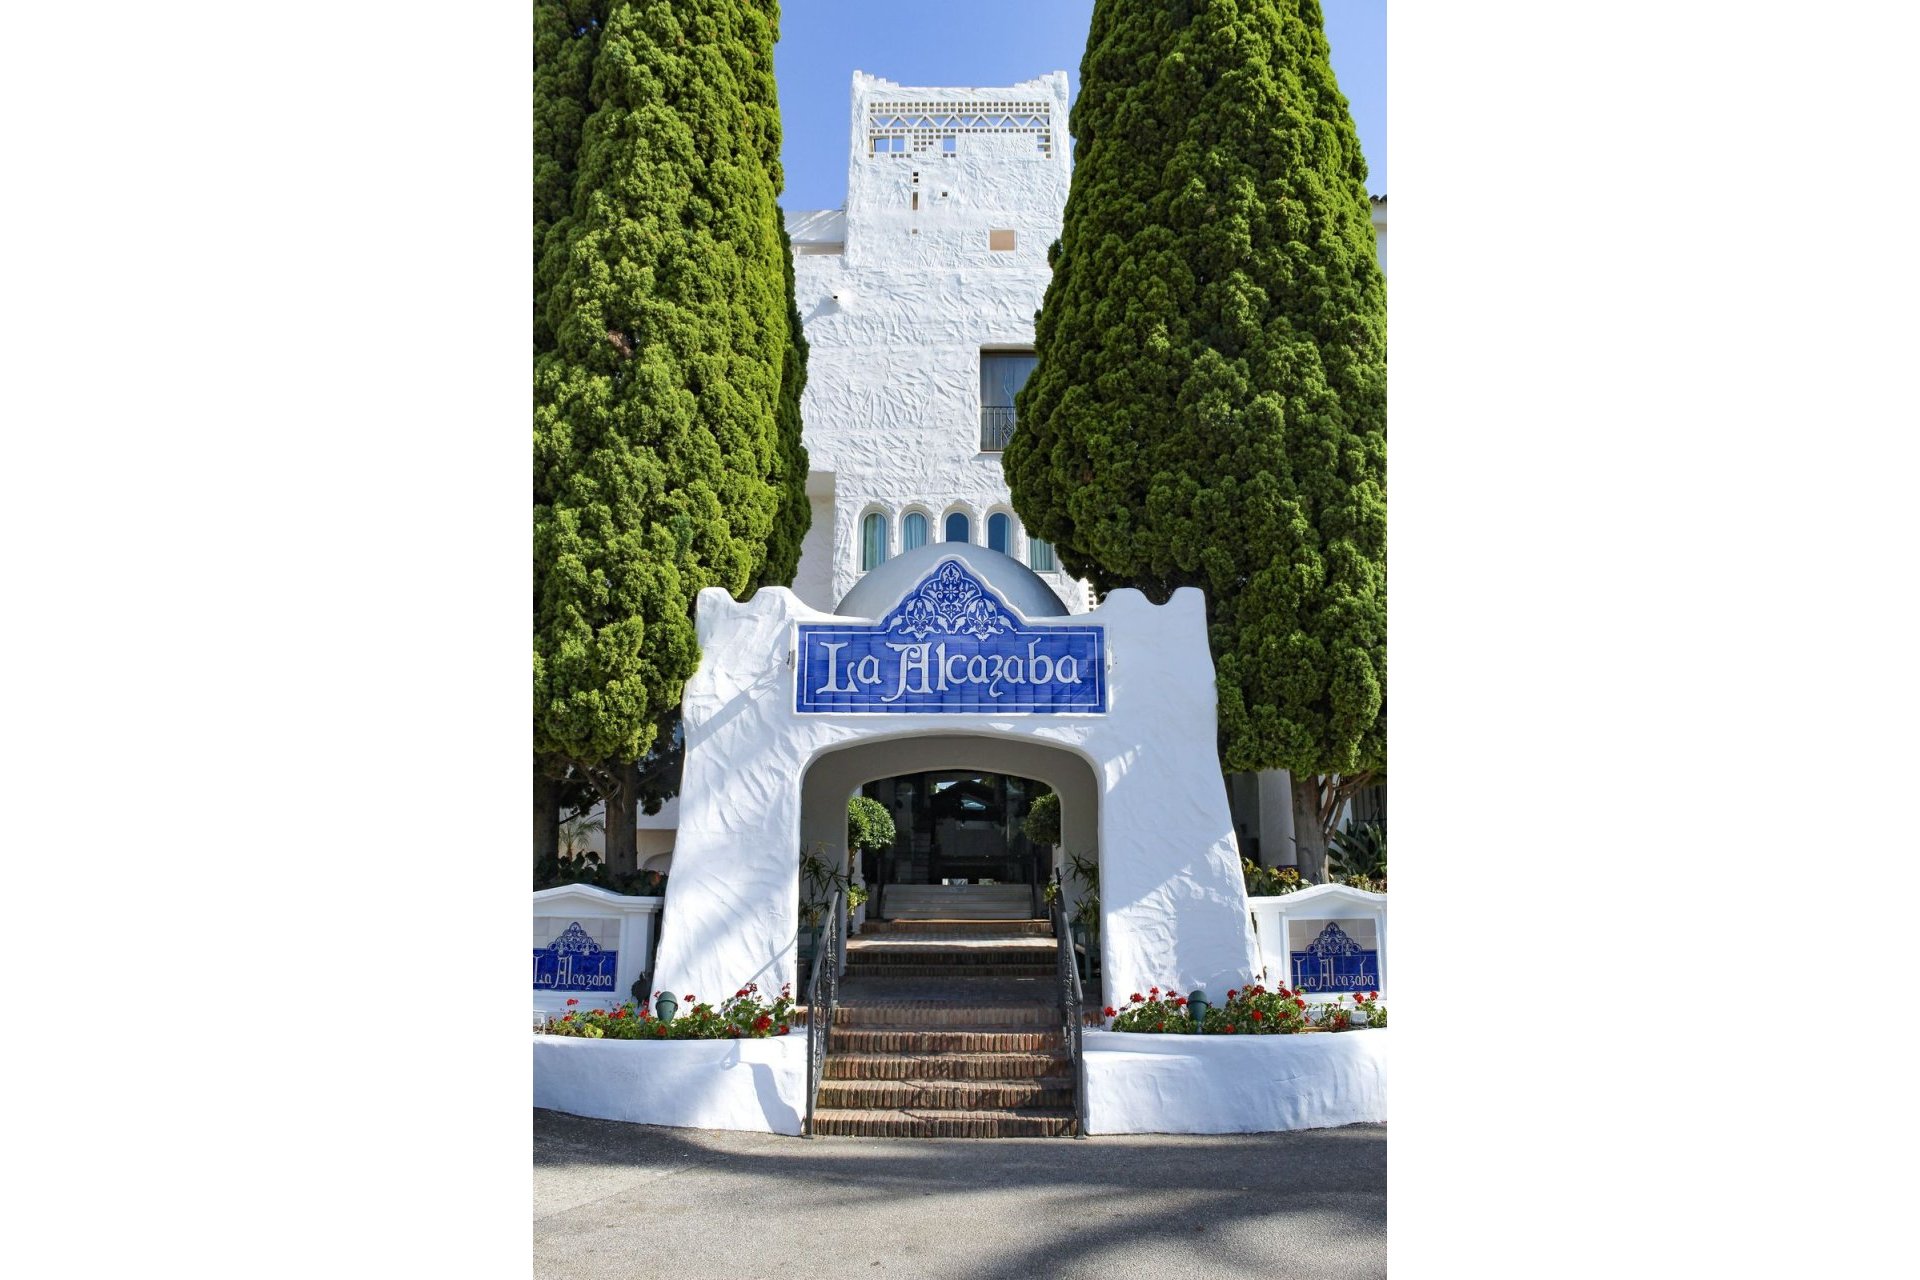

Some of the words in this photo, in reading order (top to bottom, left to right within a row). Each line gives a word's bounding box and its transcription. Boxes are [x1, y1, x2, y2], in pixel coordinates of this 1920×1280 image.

[815, 641, 882, 695] La
[880, 637, 1083, 702] Alcazaba
[533, 953, 552, 984] La
[551, 953, 613, 990] Alcazaba
[1293, 956, 1317, 987] La
[1315, 956, 1376, 990] Alcazaba
